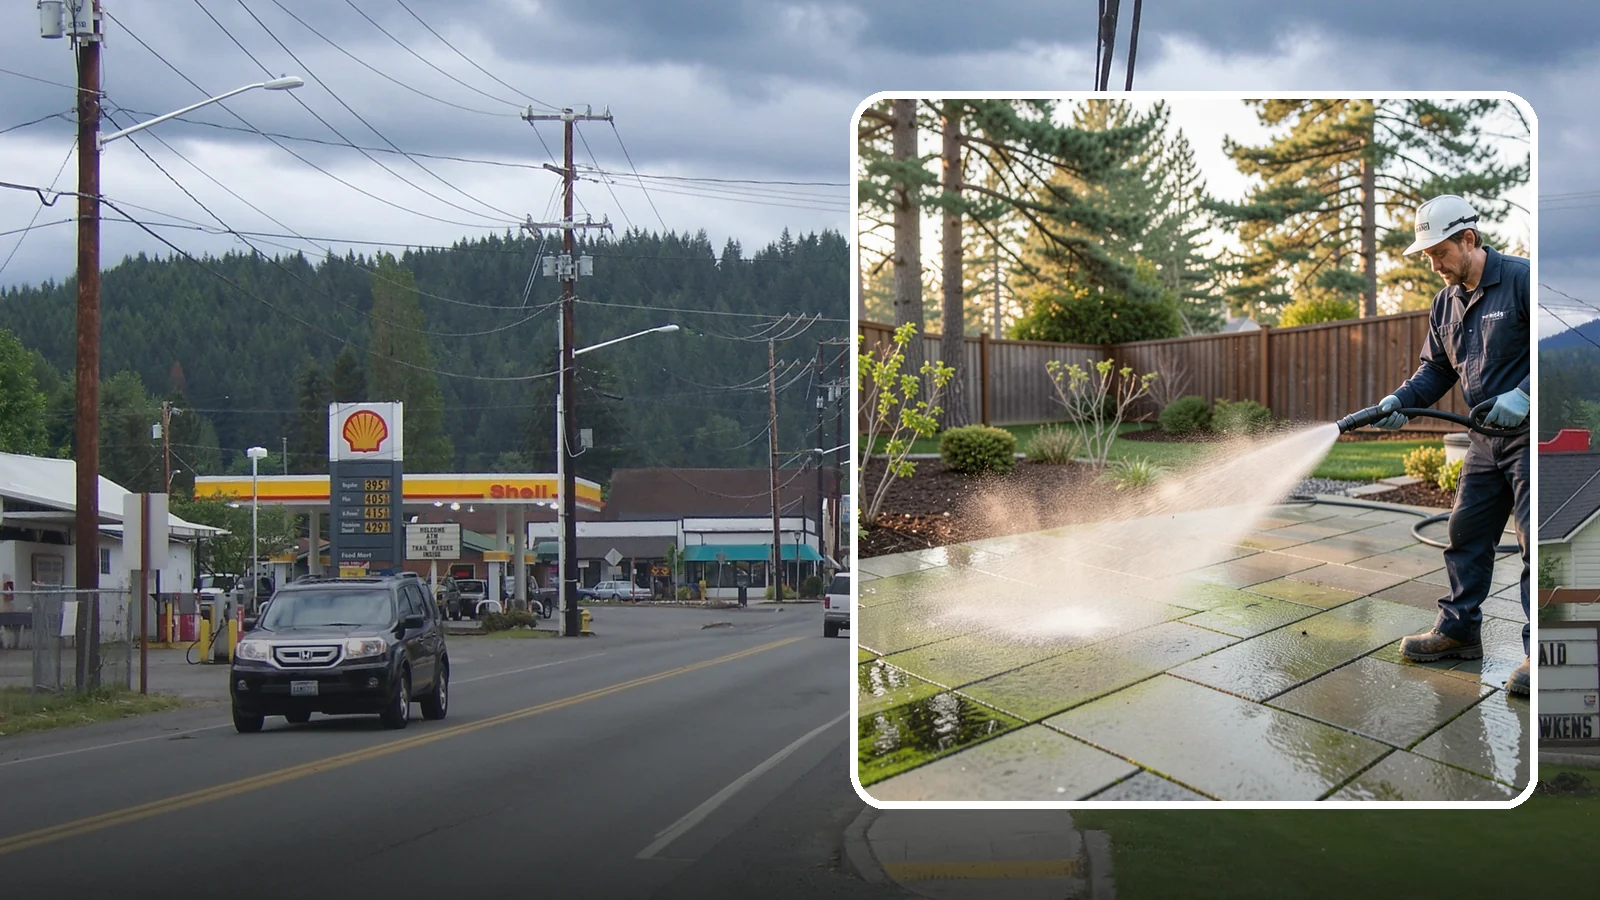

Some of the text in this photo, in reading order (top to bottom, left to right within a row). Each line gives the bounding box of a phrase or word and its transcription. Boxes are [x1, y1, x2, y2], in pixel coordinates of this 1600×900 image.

[366, 480, 383, 490] 395
[490, 484, 547, 499] Shell
[366, 494, 383, 504] 405
[366, 508, 383, 518] 415
[366, 522, 383, 532] 429
